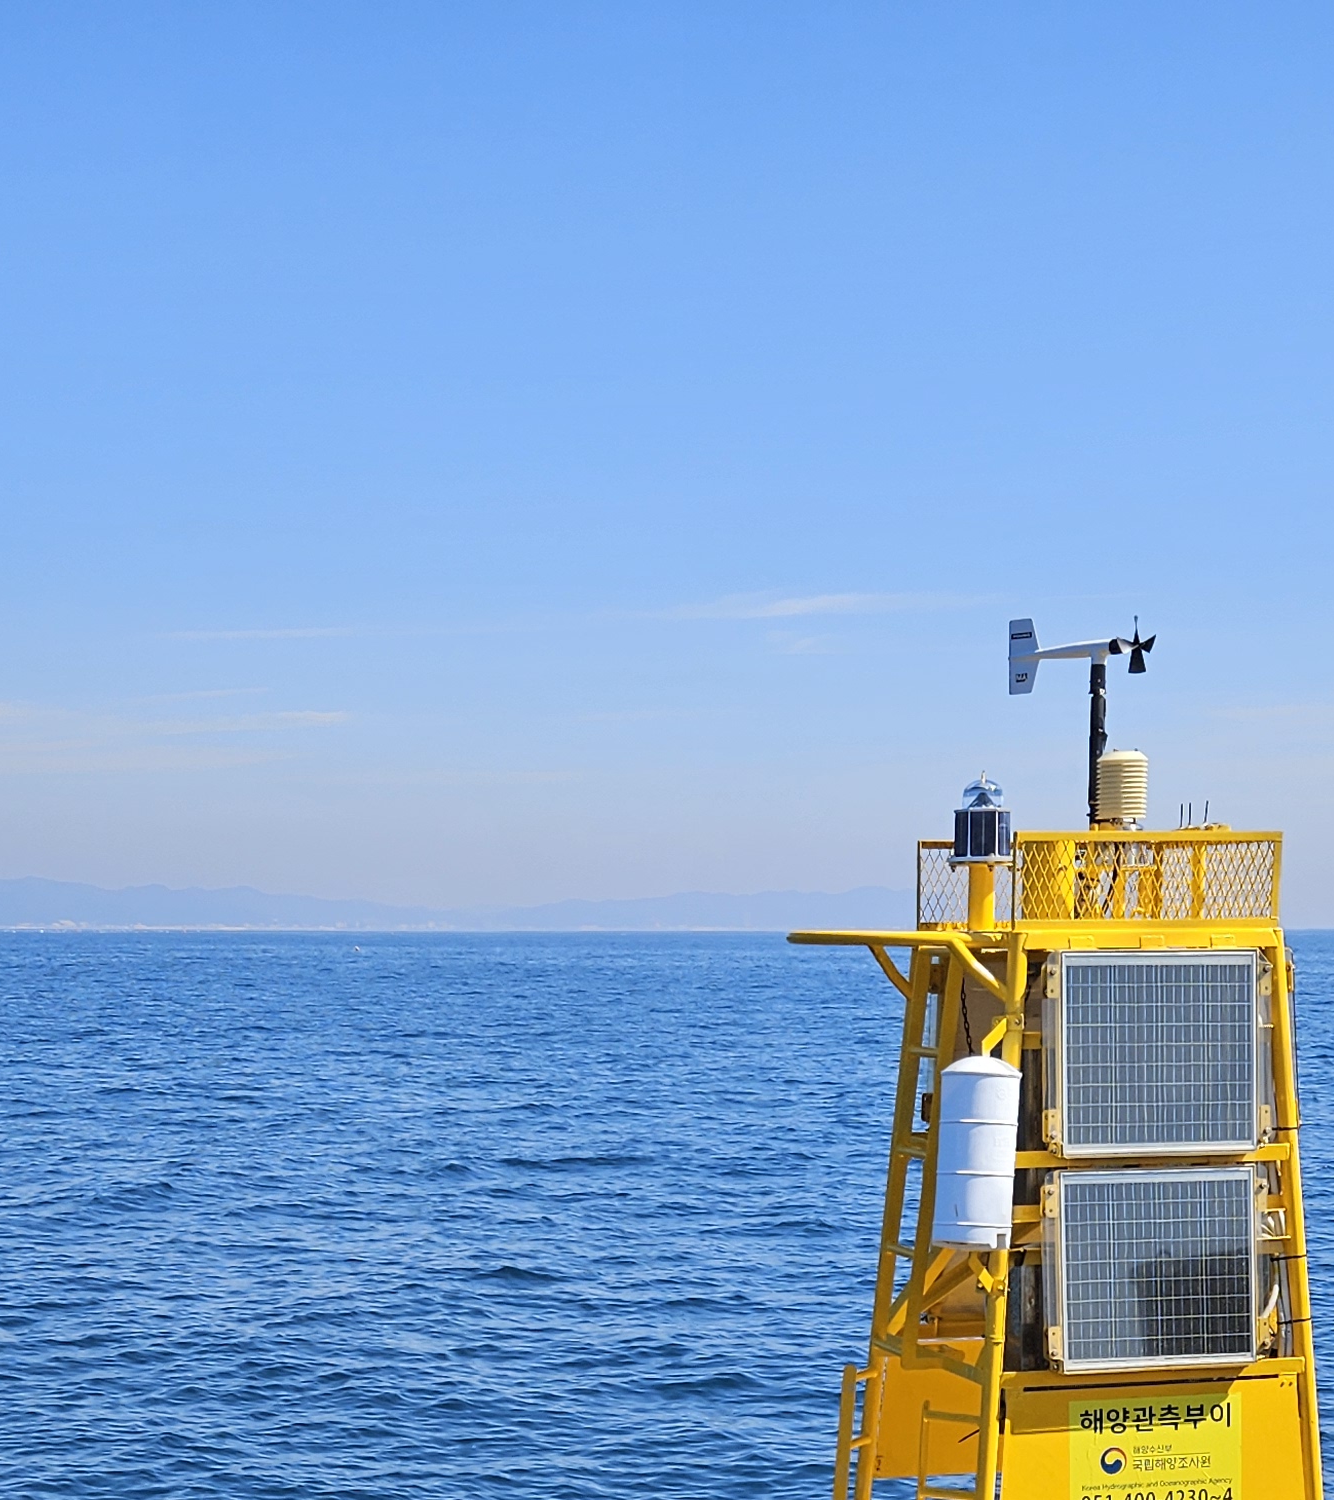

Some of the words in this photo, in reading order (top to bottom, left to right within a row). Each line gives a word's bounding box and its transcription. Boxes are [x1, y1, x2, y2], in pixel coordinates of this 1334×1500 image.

[1079, 1402, 1231, 1434] 해양관측부이
[1132, 1455, 1211, 1471] 국립해양조사원
[1081, 1484, 1101, 1492] Korea
[1102, 1482, 1144, 1491] Hydrographic
[1145, 1480, 1159, 1488] and
[1208, 1477, 1233, 1486] Agency
